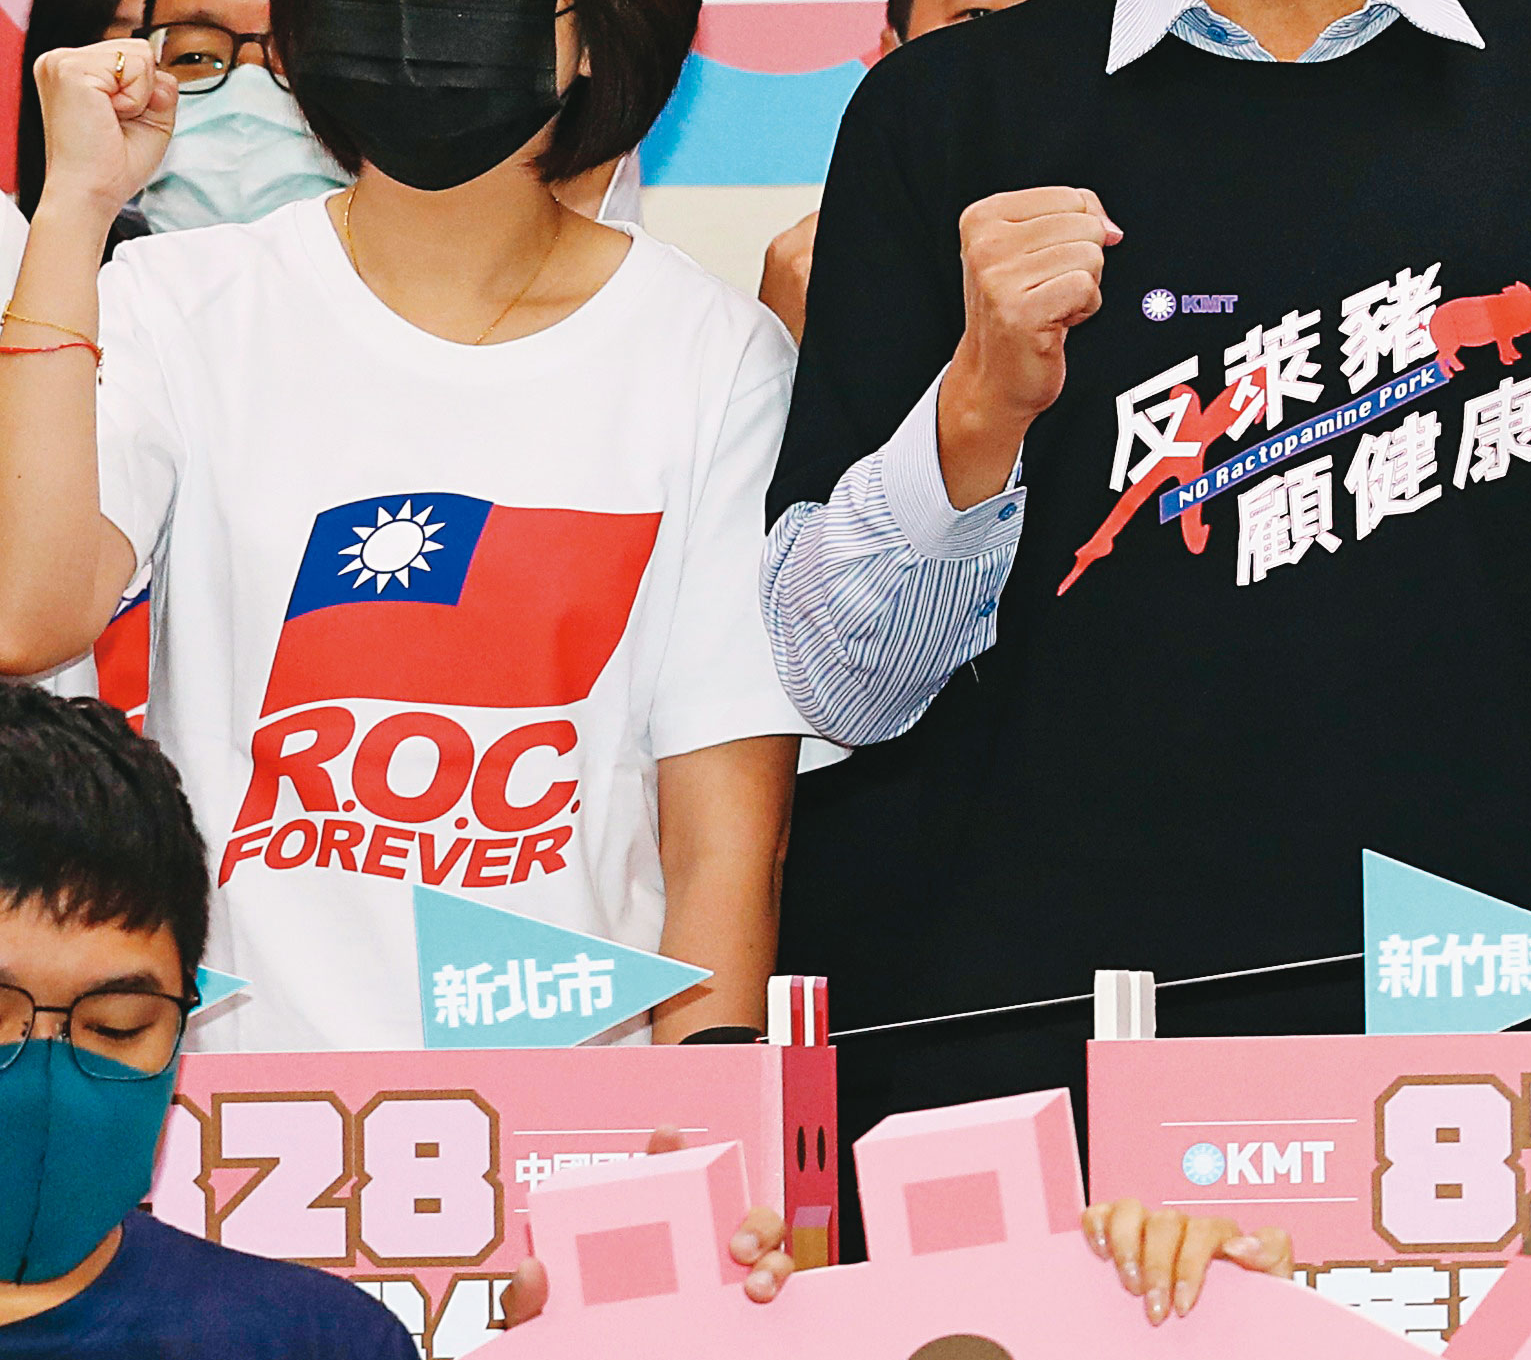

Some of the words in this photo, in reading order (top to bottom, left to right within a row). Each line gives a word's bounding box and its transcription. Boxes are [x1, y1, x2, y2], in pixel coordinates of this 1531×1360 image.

[1181, 293, 1239, 315] KMT
[1108, 262, 1442, 492] 反萊豬
[1177, 481, 1210, 509] NO
[1214, 398, 1374, 489] Ractopamine
[1378, 368, 1437, 409] Pork
[231, 706, 581, 834] R.O.C.
[217, 822, 574, 890] FOREVER
[432, 954, 616, 1030] 新北市
[1225, 1140, 1336, 1186] KMT
